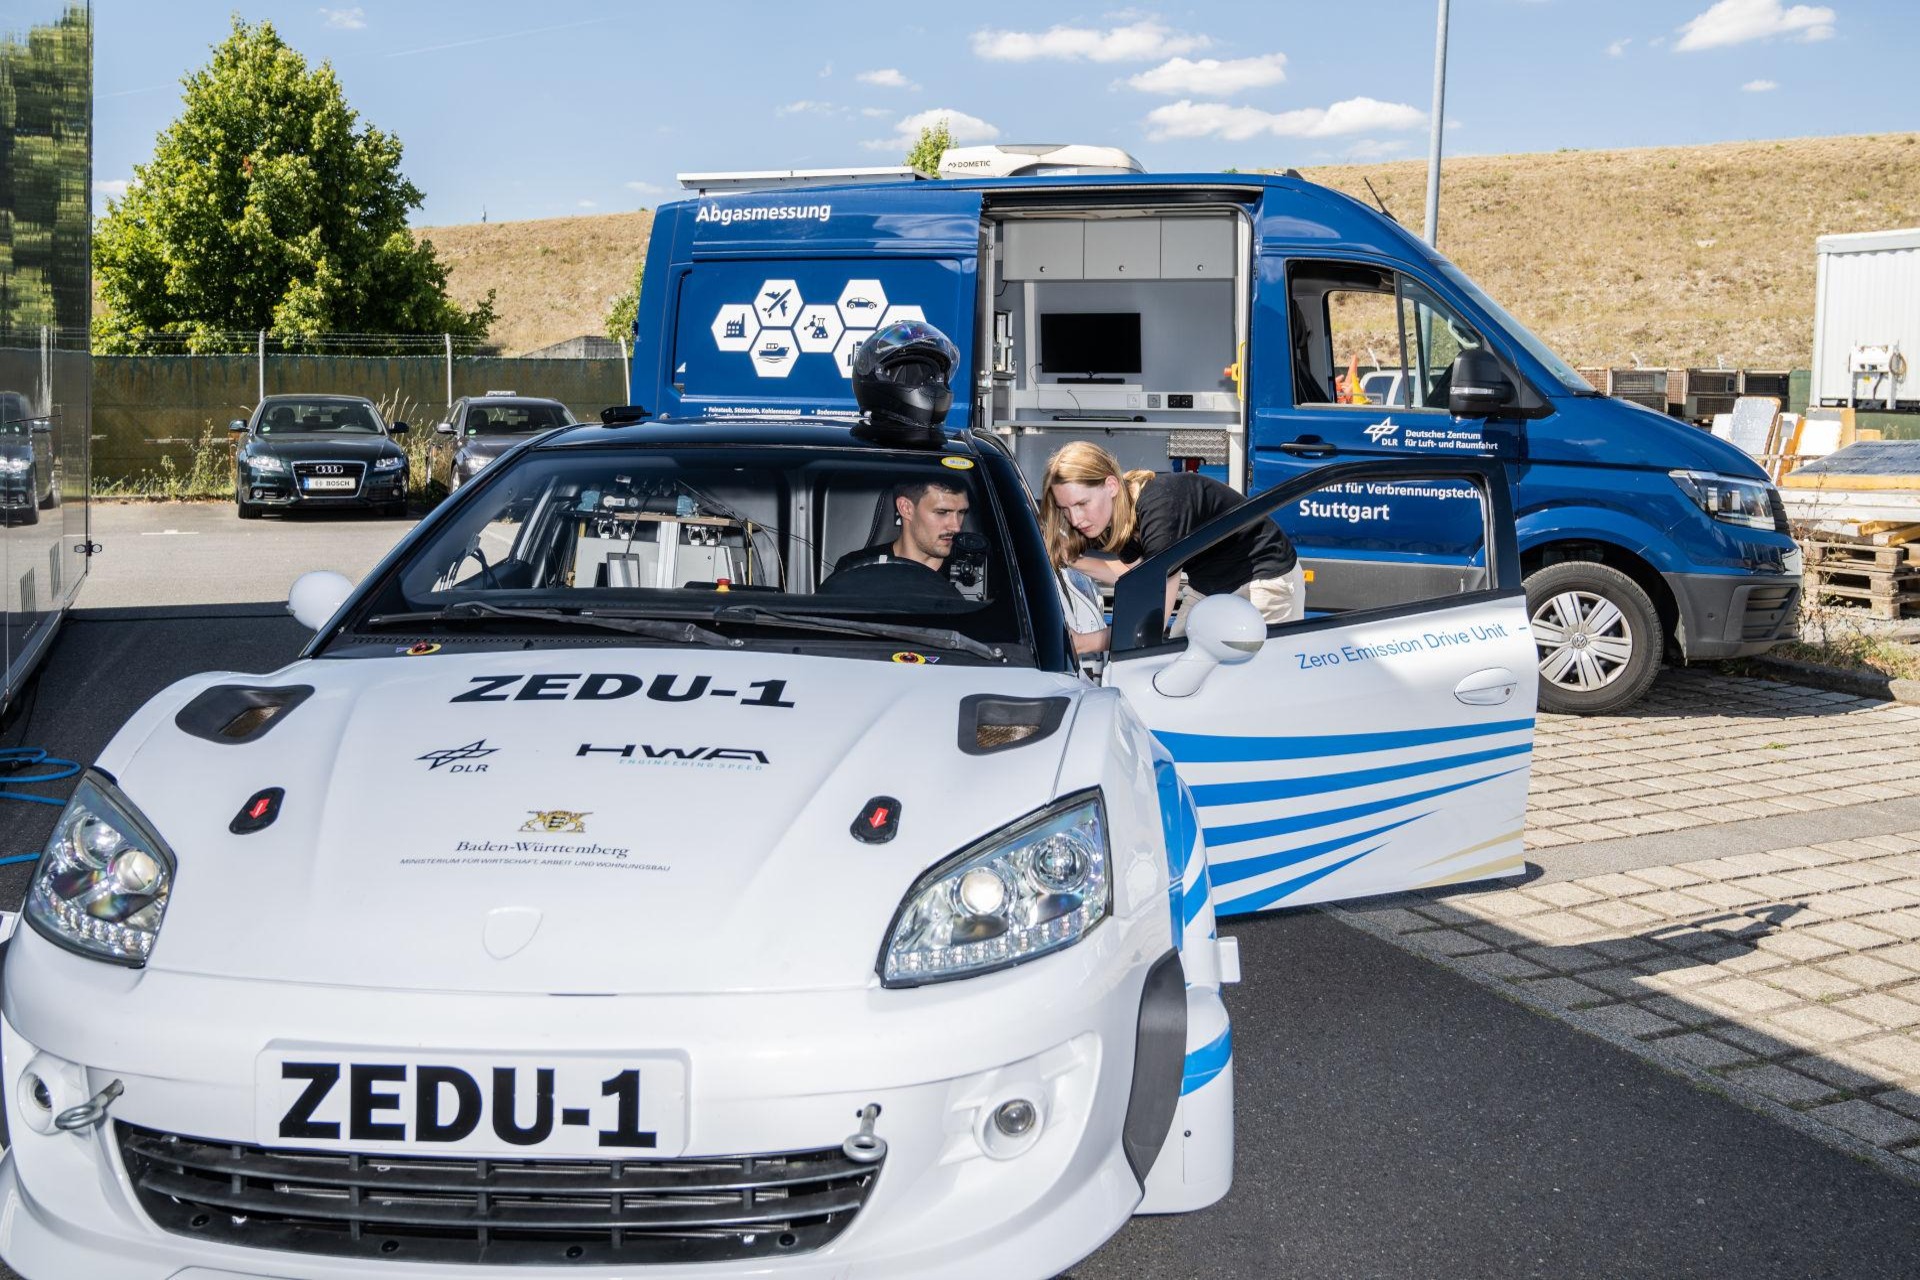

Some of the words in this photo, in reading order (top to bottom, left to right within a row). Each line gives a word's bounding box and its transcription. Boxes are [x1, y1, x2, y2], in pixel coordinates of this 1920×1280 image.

[957, 160, 991, 168] DOMETIC
[695, 203, 831, 226] Abgasmessung
[1405, 429, 1446, 439] Deutsches
[1447, 431, 1481, 440] Zentrum
[1381, 438, 1398, 446] DLR
[1404, 438, 1417, 447] für
[1418, 439, 1437, 448] Luft-
[1438, 440, 1454, 448] und
[1456, 441, 1499, 450] Raumfahrt
[1344, 482, 1364, 494] für
[1299, 499, 1390, 523] Stuttgart
[1294, 652, 1340, 670] Zero
[1341, 638, 1420, 663] Emission
[1422, 631, 1469, 649] Drive
[1473, 623, 1508, 642] Unit
[449, 673, 796, 708] ZEDU-1
[576, 743, 770, 764] HWA
[449, 764, 489, 773] DLR
[618, 758, 714, 769] ENGINEERING
[718, 762, 763, 772] SPEED
[455, 839, 631, 860] Baden-Württemberg
[596, 861, 671, 872] WOHNUNGSBAU
[278, 1061, 657, 1149] ZEDU-1
